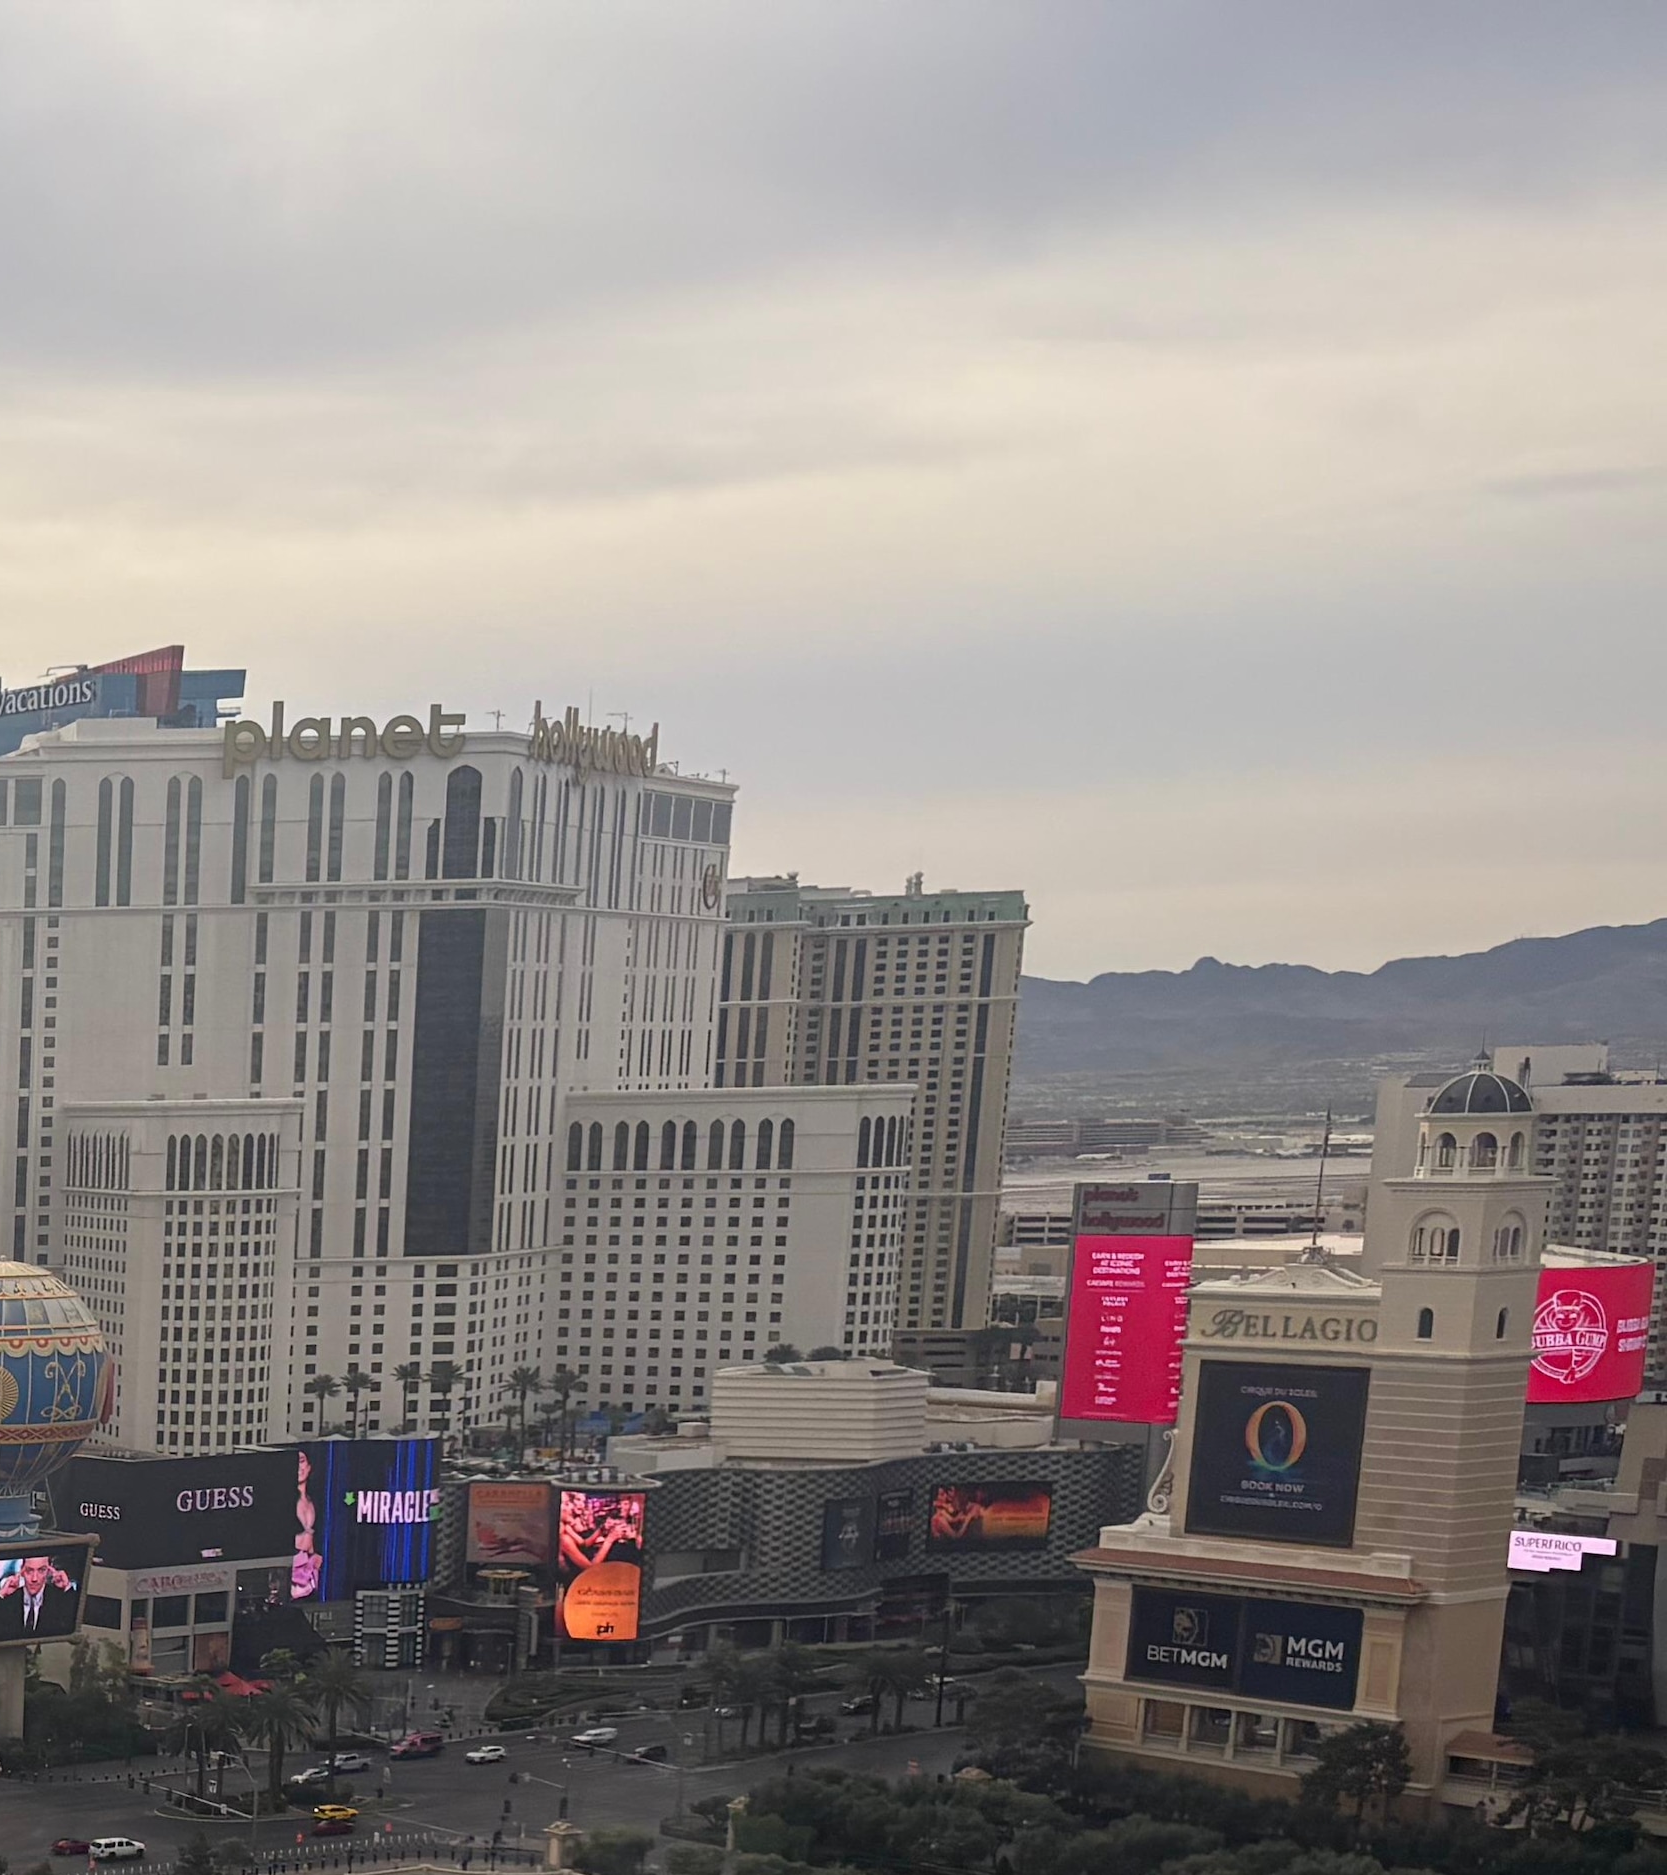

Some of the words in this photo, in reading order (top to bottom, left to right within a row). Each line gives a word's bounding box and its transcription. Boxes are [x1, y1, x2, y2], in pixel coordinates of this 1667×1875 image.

[222, 701, 466, 779] planet
[530, 700, 659, 785] hollywood
[1082, 1186, 1139, 1206] planet
[1081, 1211, 1165, 1232] hollywood
[1200, 1309, 1378, 1342] BELLAGIO
[1245, 1400, 1307, 1472] O
[176, 1485, 255, 1513] GUESS
[1240, 1480, 1274, 1491] BOOK
[1275, 1481, 1305, 1493] NOW
[79, 1502, 121, 1520] GUESS
[356, 1489, 431, 1524] MIRACLE
[1514, 1536, 1582, 1552] SUPERFRICO
[1147, 1644, 1228, 1669] BETMGM
[1286, 1636, 1345, 1661] MGM
[1285, 1657, 1343, 1673] REWARDS
